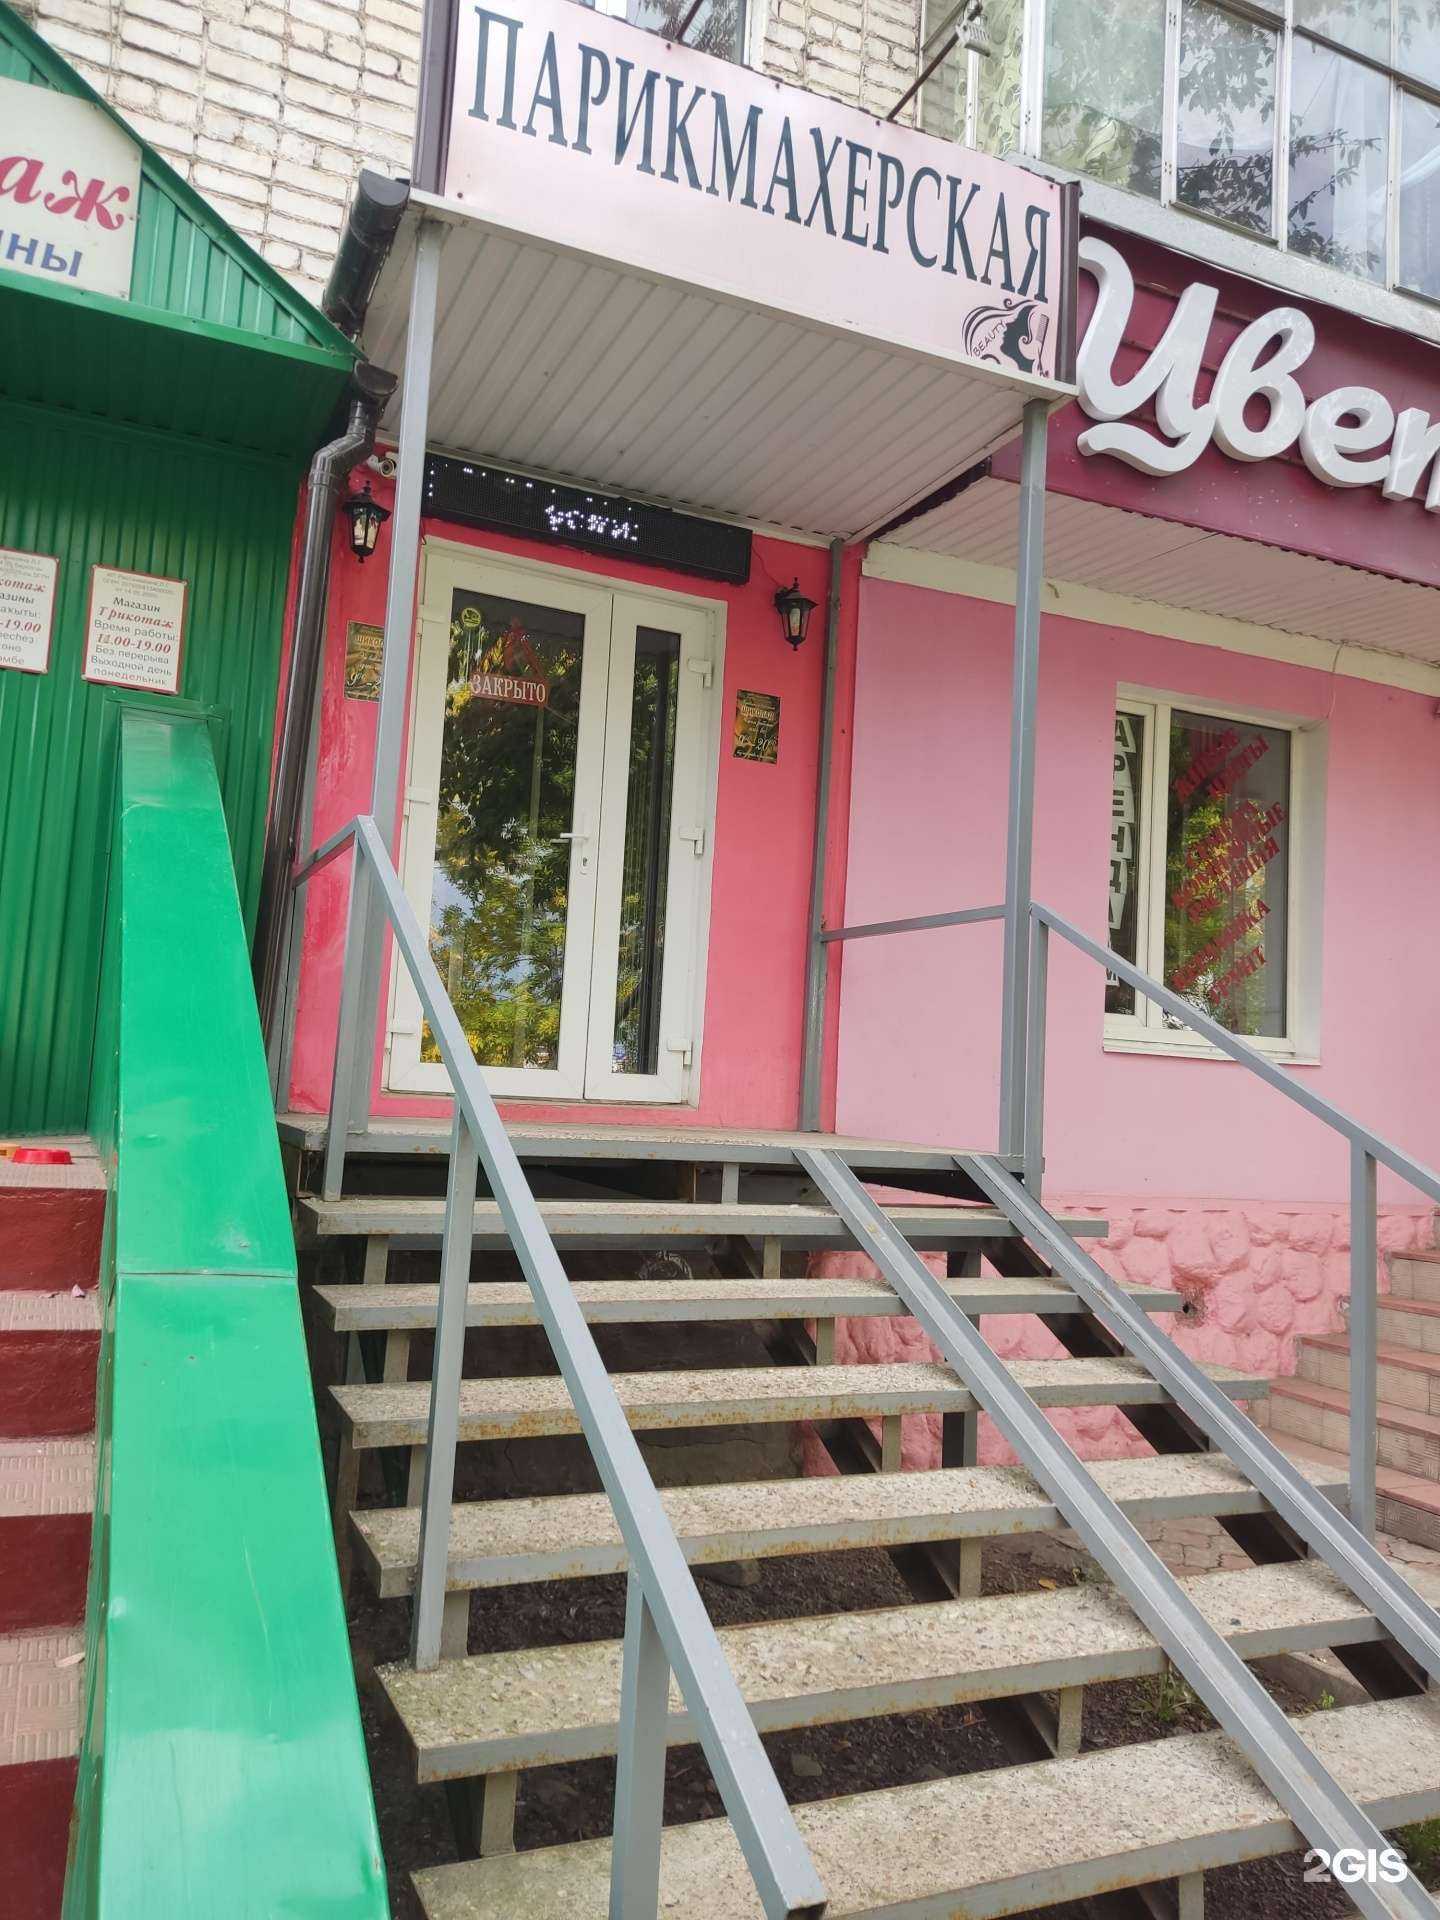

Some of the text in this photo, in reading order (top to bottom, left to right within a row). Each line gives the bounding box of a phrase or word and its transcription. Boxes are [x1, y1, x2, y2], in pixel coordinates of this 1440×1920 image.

[468, 8, 1050, 303] ПАРИКМАХЕРСКАЯ
[0, 229, 83, 277] ны
[972, 320, 1008, 357] BEAUTY
[113, 596, 161, 612] Магазин
[94, 619, 130, 634] Время
[98, 606, 174, 629] Трикотаж
[91, 655, 172, 676] Выходной день
[96, 645, 169, 664] Без перерыва
[95, 668, 166, 684] понедельник
[471, 674, 546, 702] ЗАКРЫТО
